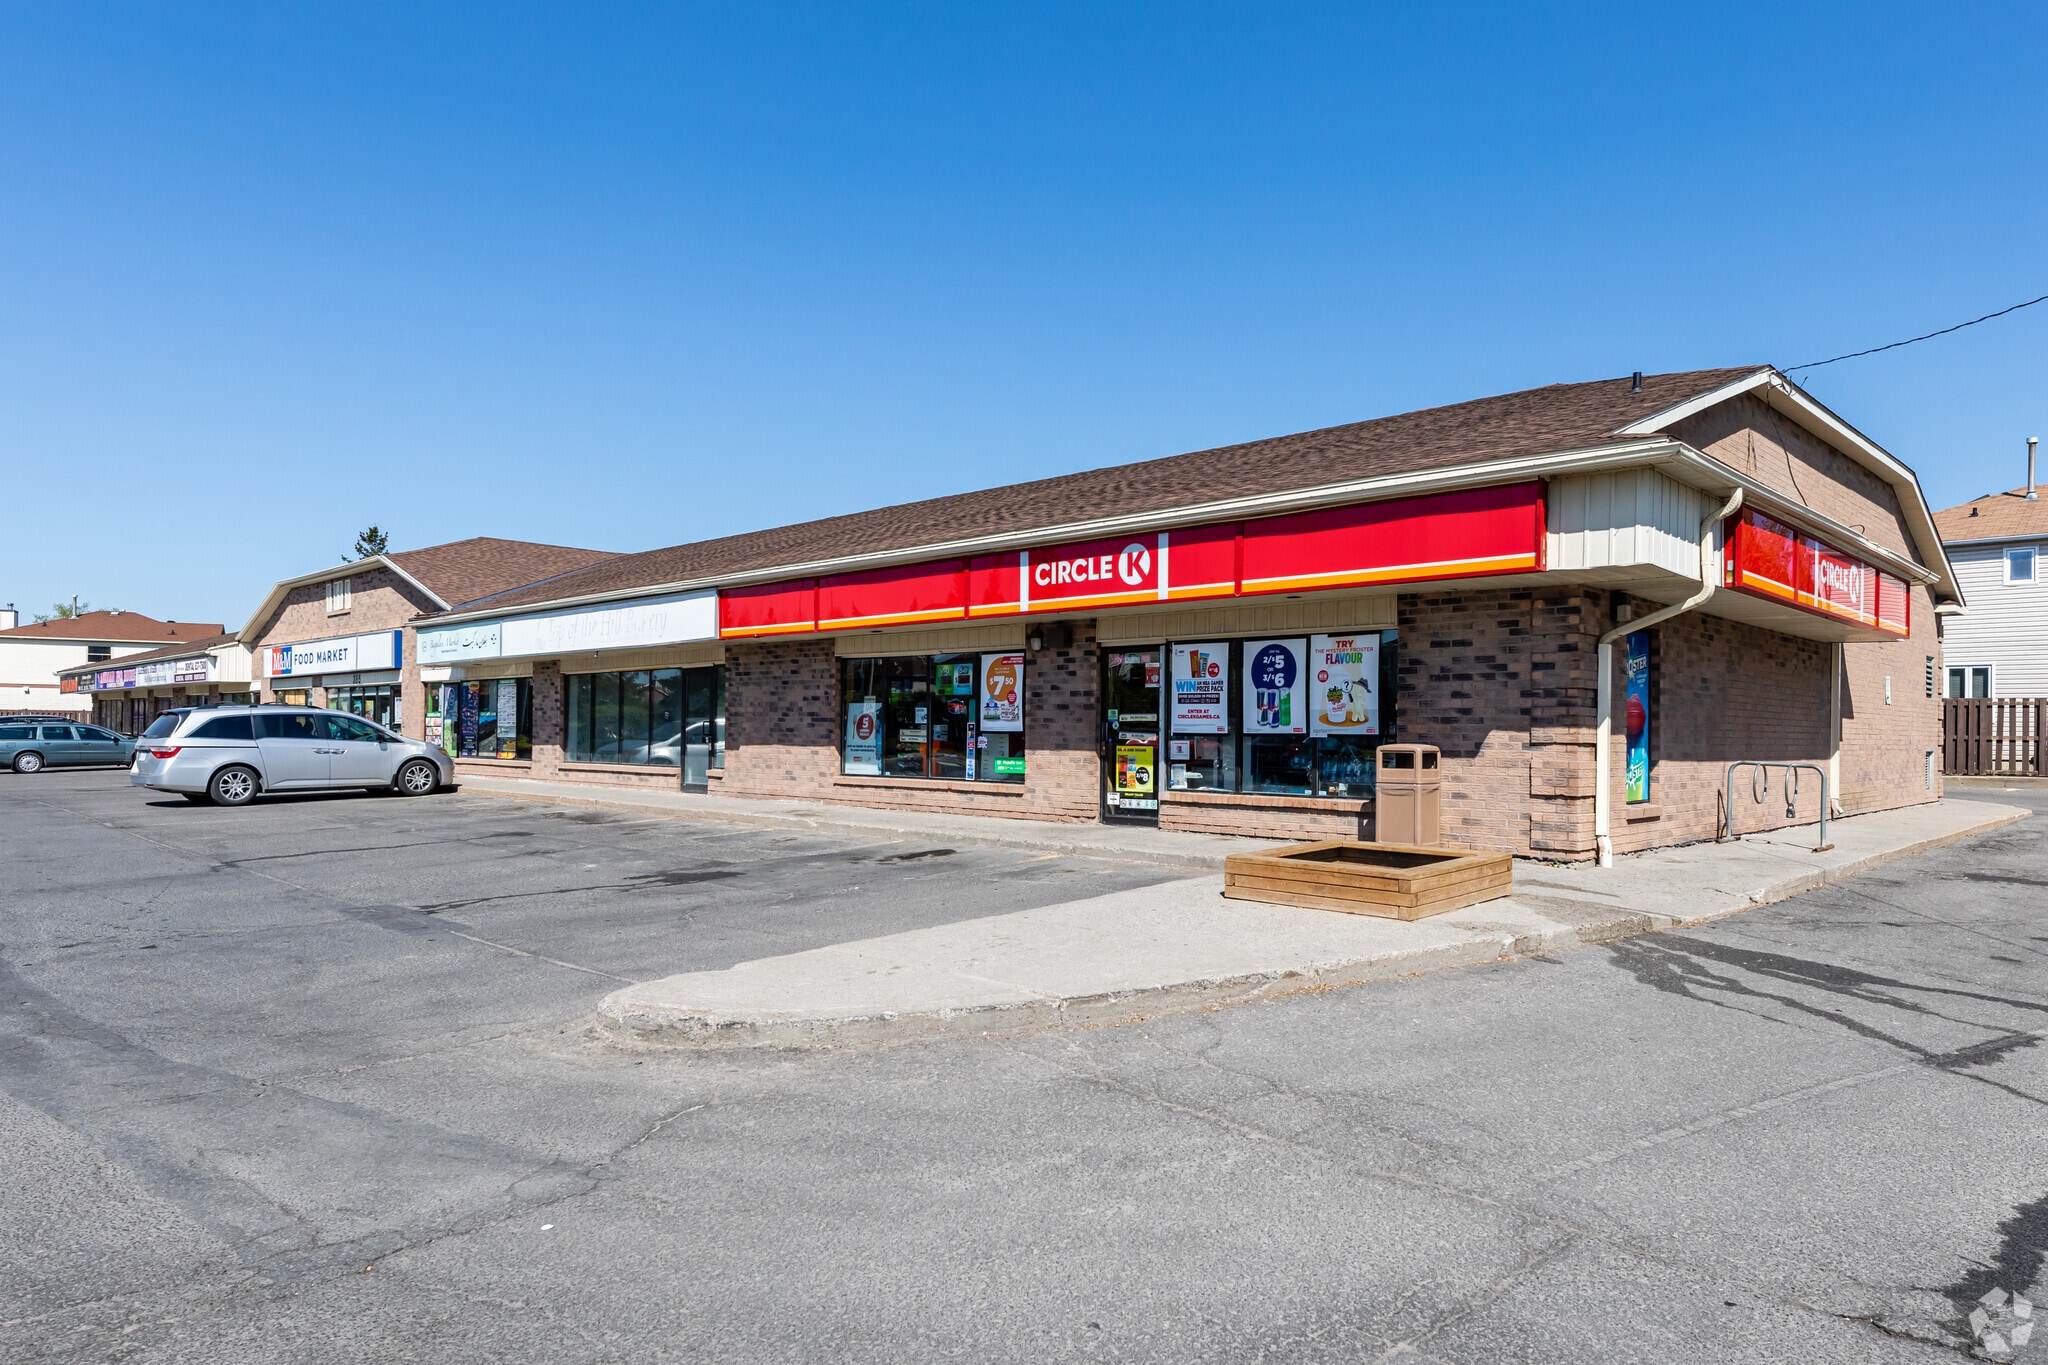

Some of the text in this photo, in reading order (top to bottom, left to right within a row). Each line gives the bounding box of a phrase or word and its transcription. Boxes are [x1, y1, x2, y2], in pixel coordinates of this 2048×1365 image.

[1035, 546, 1149, 586] CIRCLE K
[1821, 559, 1849, 592] CIRCLE
[601, 610, 622, 636] Hill
[272, 648, 348, 671] M&M FOOD MARKET
[1326, 653, 1363, 664] FLAVOUR
[1626, 656, 1647, 675] OSTER
[1176, 681, 1196, 692] WIN
[862, 717, 869, 728] 5
